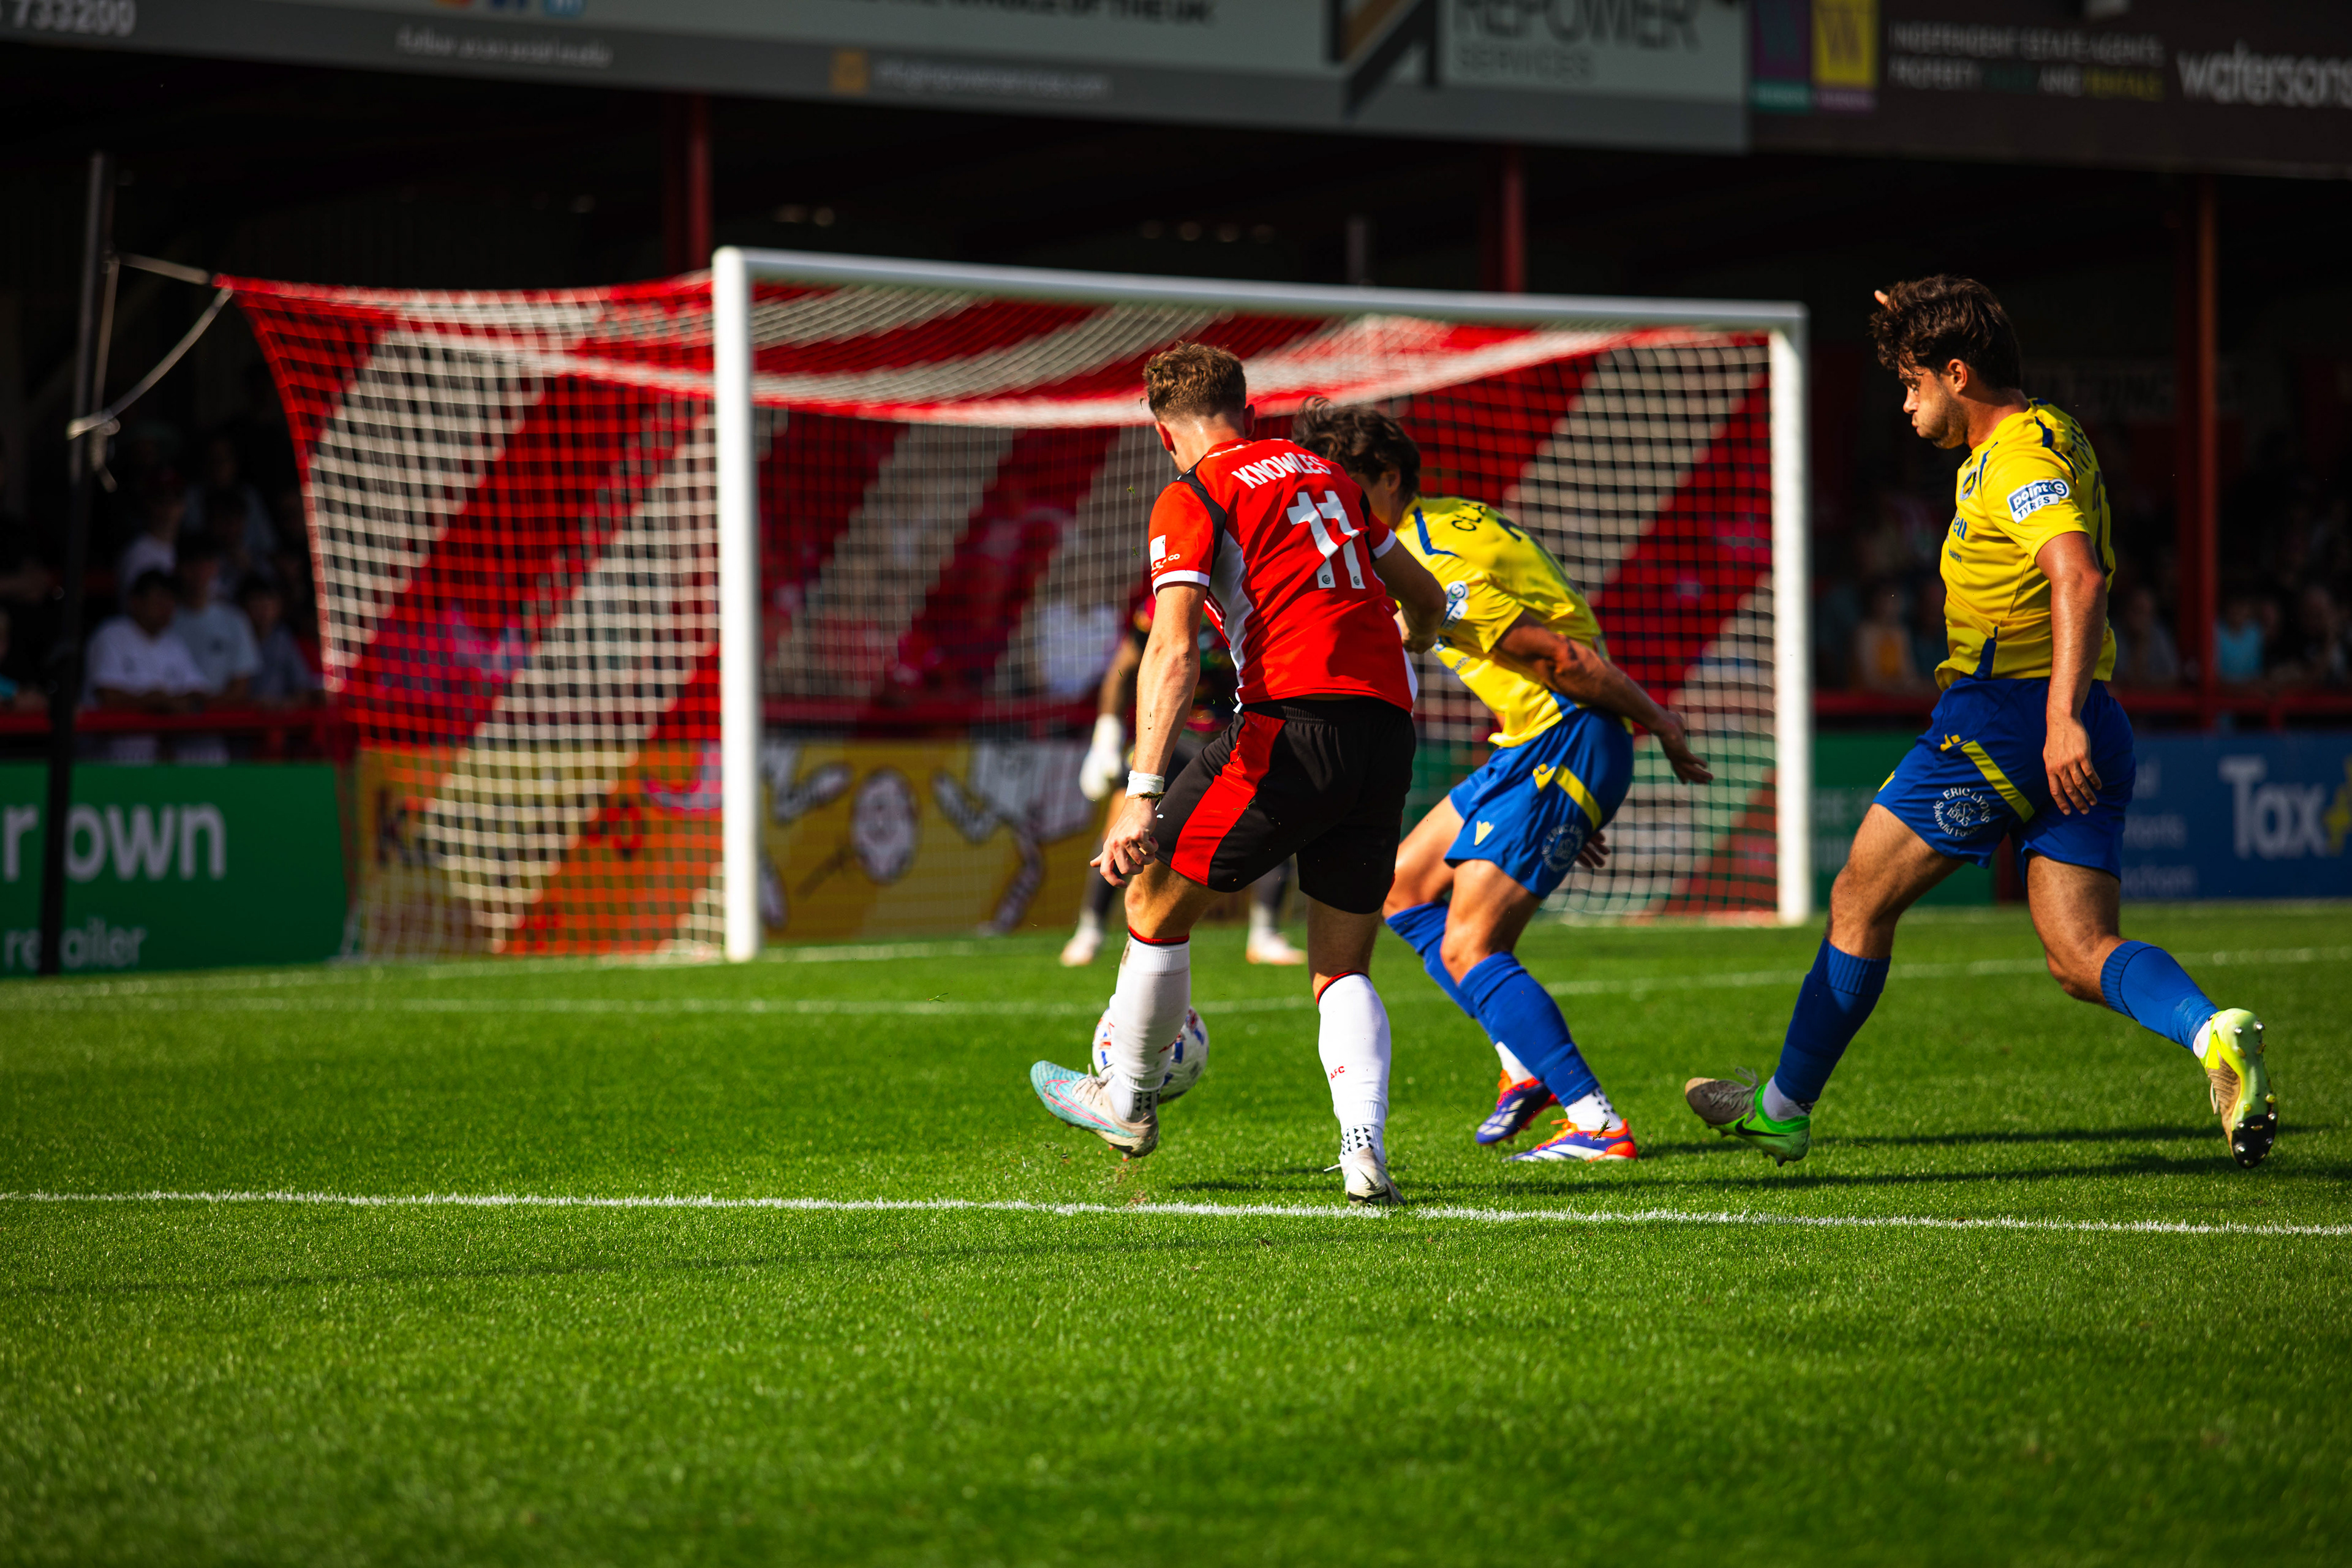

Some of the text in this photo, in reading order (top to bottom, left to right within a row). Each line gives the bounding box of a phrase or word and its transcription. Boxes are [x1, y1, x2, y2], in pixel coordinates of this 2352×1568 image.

[1232, 452, 1332, 489] KNOWLES
[2013, 483, 2048, 510] point
[2018, 496, 2051, 518] TYRES
[1287, 491, 1366, 589] 11
[1933, 800, 1954, 835] Splendid
[1943, 787, 1991, 823] ERIC LYONS
[1954, 801, 1976, 818] EST
[5, 916, 146, 969] reailer
[1330, 1065, 1345, 1082] AFC
